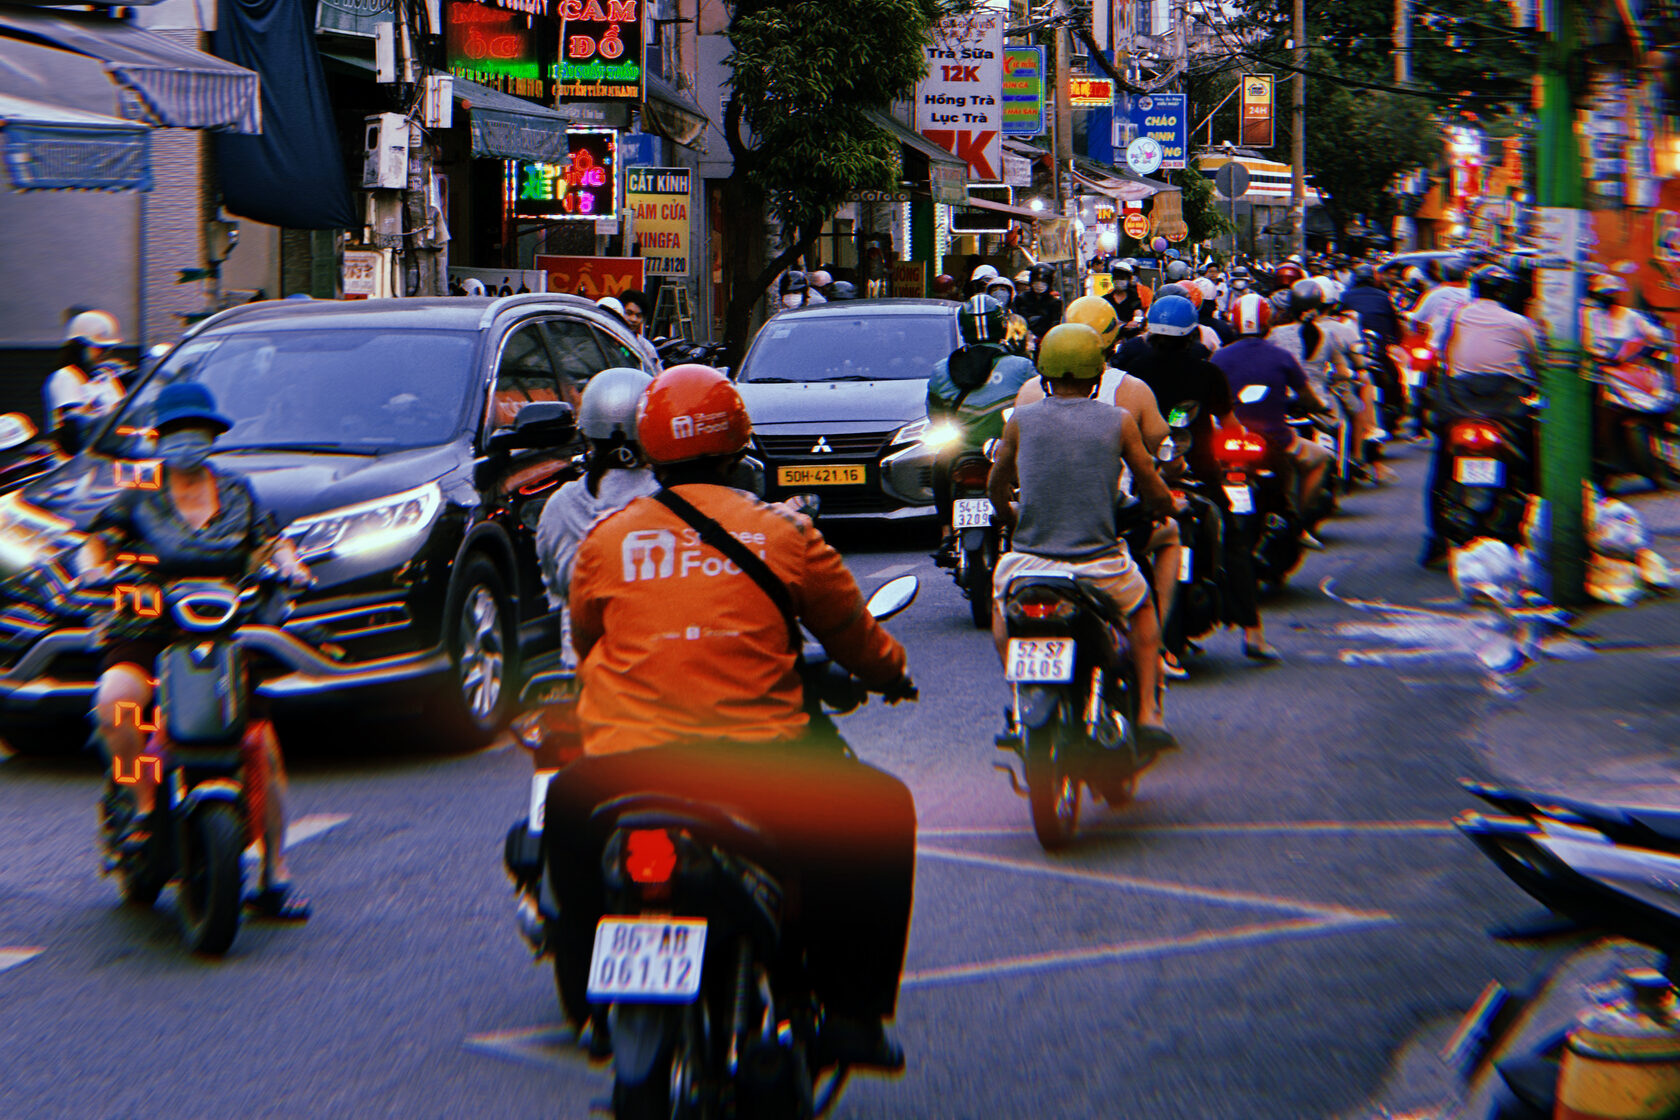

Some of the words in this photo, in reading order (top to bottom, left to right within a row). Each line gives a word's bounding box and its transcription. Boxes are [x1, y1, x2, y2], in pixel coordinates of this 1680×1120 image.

[569, 24, 624, 58] ĐỒ
[928, 48, 956, 59] Trà
[961, 47, 994, 59] Sữa
[941, 65, 981, 82] 12K
[970, 94, 995, 105] Trà
[1249, 106, 1267, 114] 24H
[931, 112, 959, 125] Lục
[963, 112, 988, 123] Trà
[1145, 114, 1177, 126] CHÁO
[629, 164, 654, 191] CẮT
[657, 171, 687, 192] KÍNH
[661, 199, 687, 220] CỬA
[1097, 208, 1111, 219] IN
[636, 232, 681, 248] XINGFA
[785, 469, 858, 482] 50H-421.16
[958, 513, 988, 525] 3209
[1015, 660, 1063, 679] 0405
